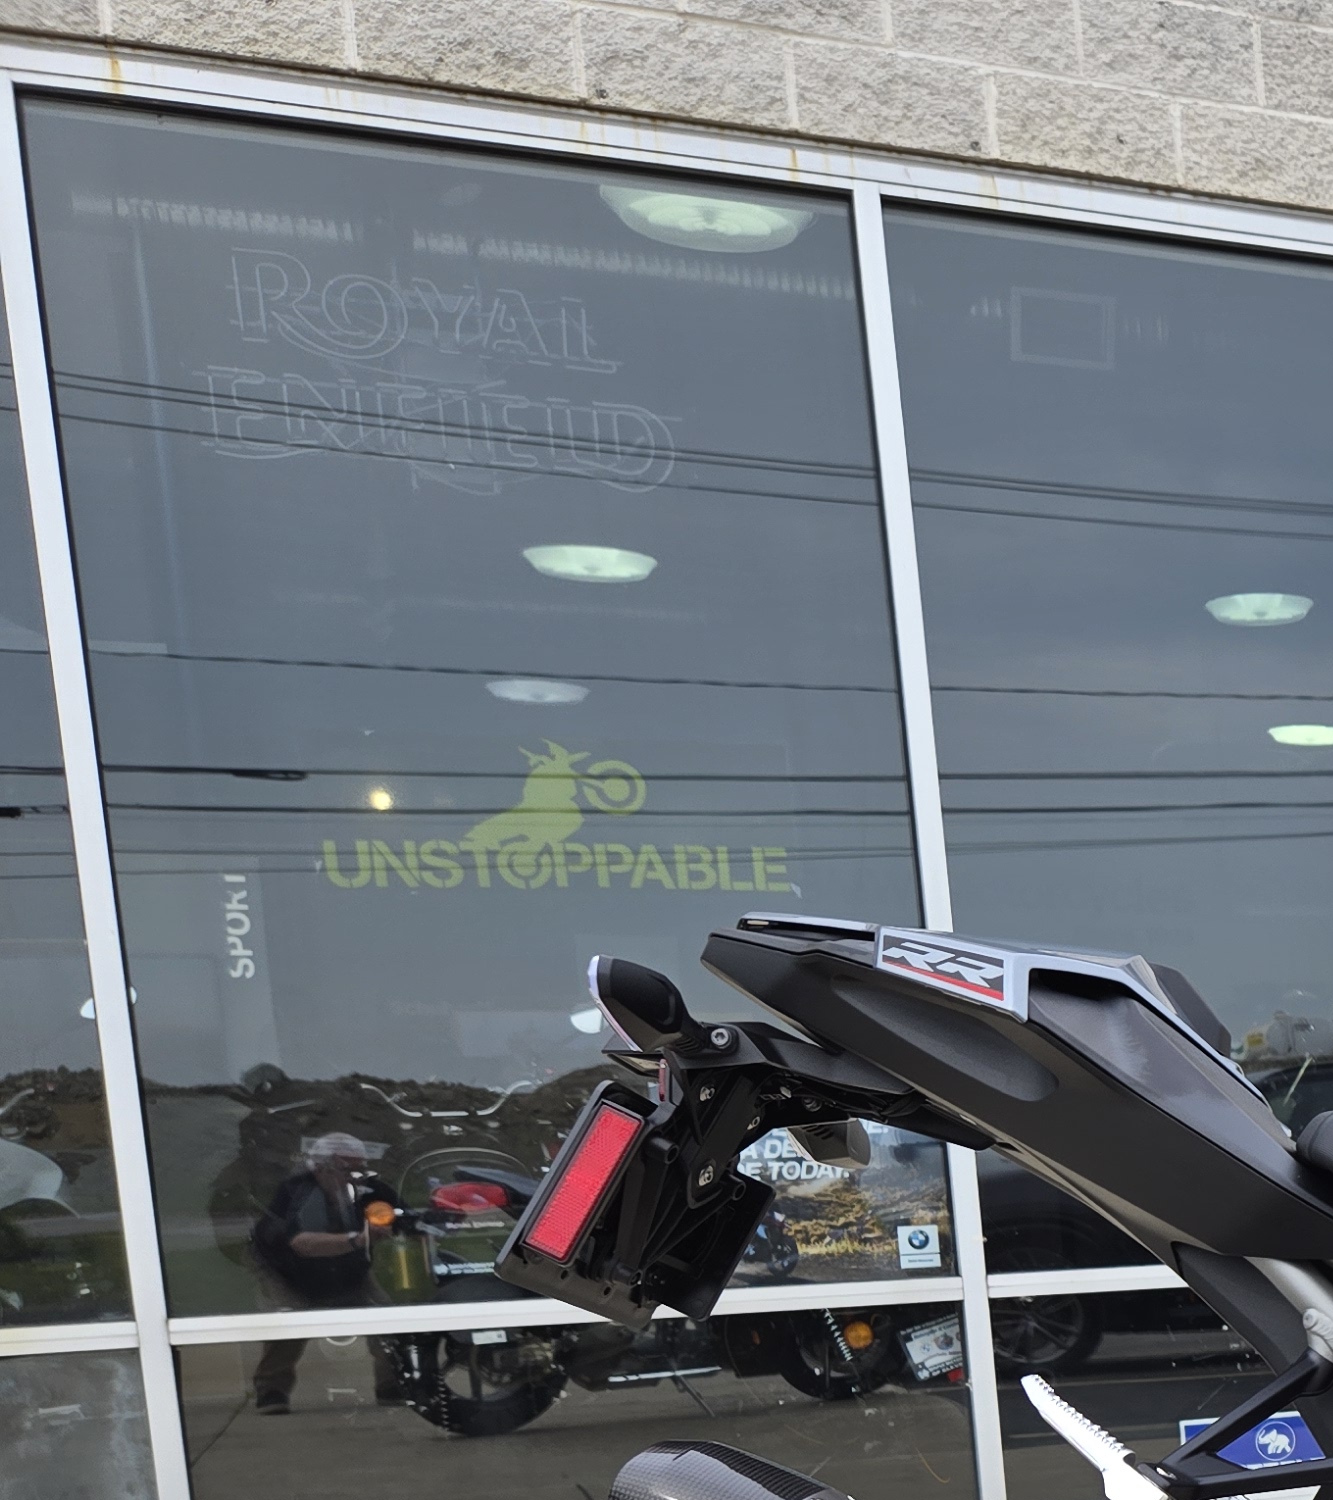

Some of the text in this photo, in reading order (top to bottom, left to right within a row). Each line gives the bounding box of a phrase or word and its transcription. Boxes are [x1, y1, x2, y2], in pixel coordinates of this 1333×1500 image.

[229, 246, 622, 374] ROYAL
[321, 838, 792, 893] UNSTOPPABLE
[882, 941, 1005, 988] RR
